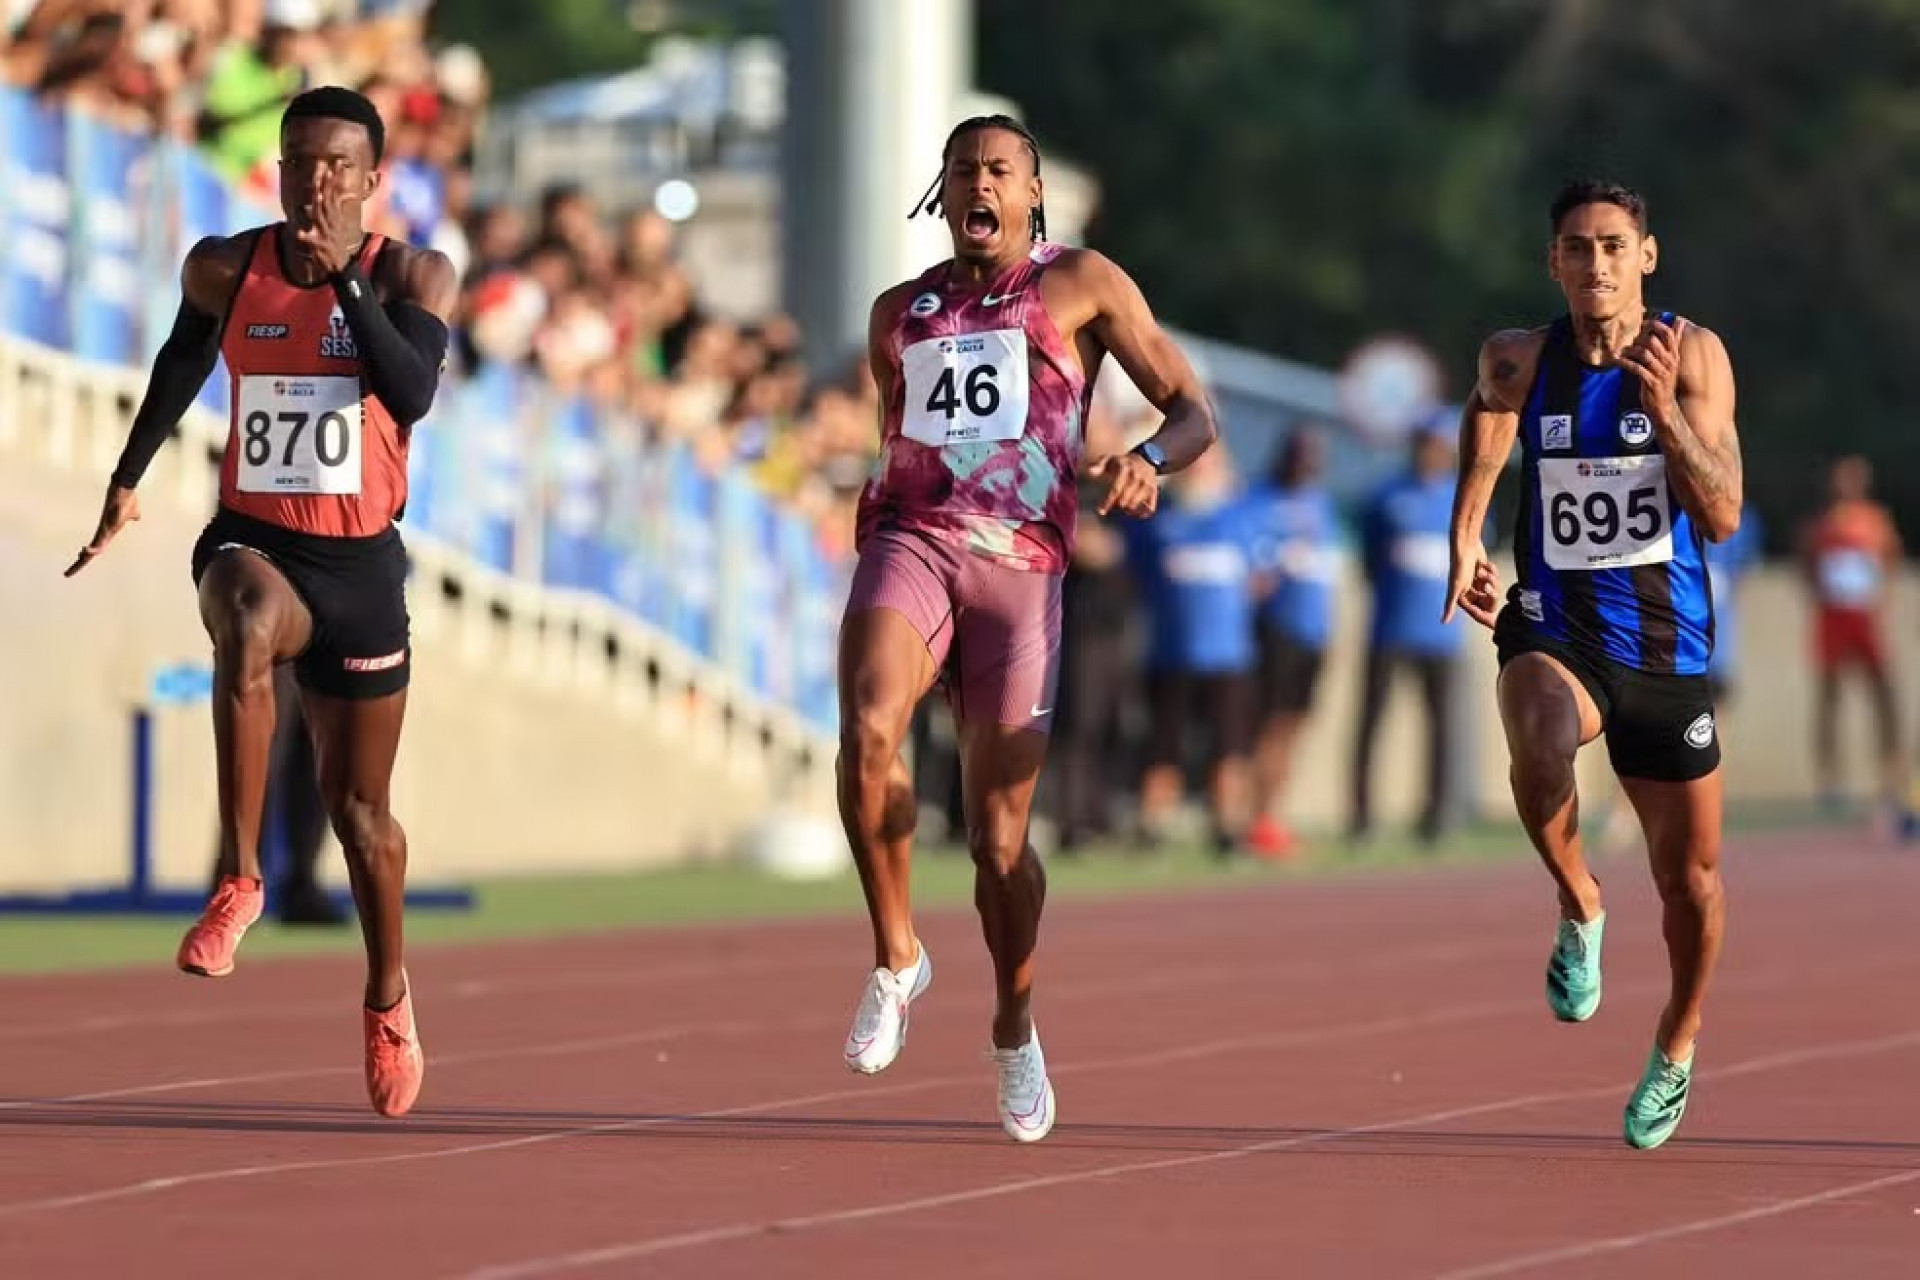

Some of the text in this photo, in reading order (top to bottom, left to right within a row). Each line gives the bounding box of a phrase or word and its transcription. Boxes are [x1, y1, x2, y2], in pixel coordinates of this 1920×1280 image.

[247, 325, 286, 337] FIESP
[926, 364, 1000, 419] 46
[245, 410, 350, 467] 870
[1551, 487, 1661, 546] 695
